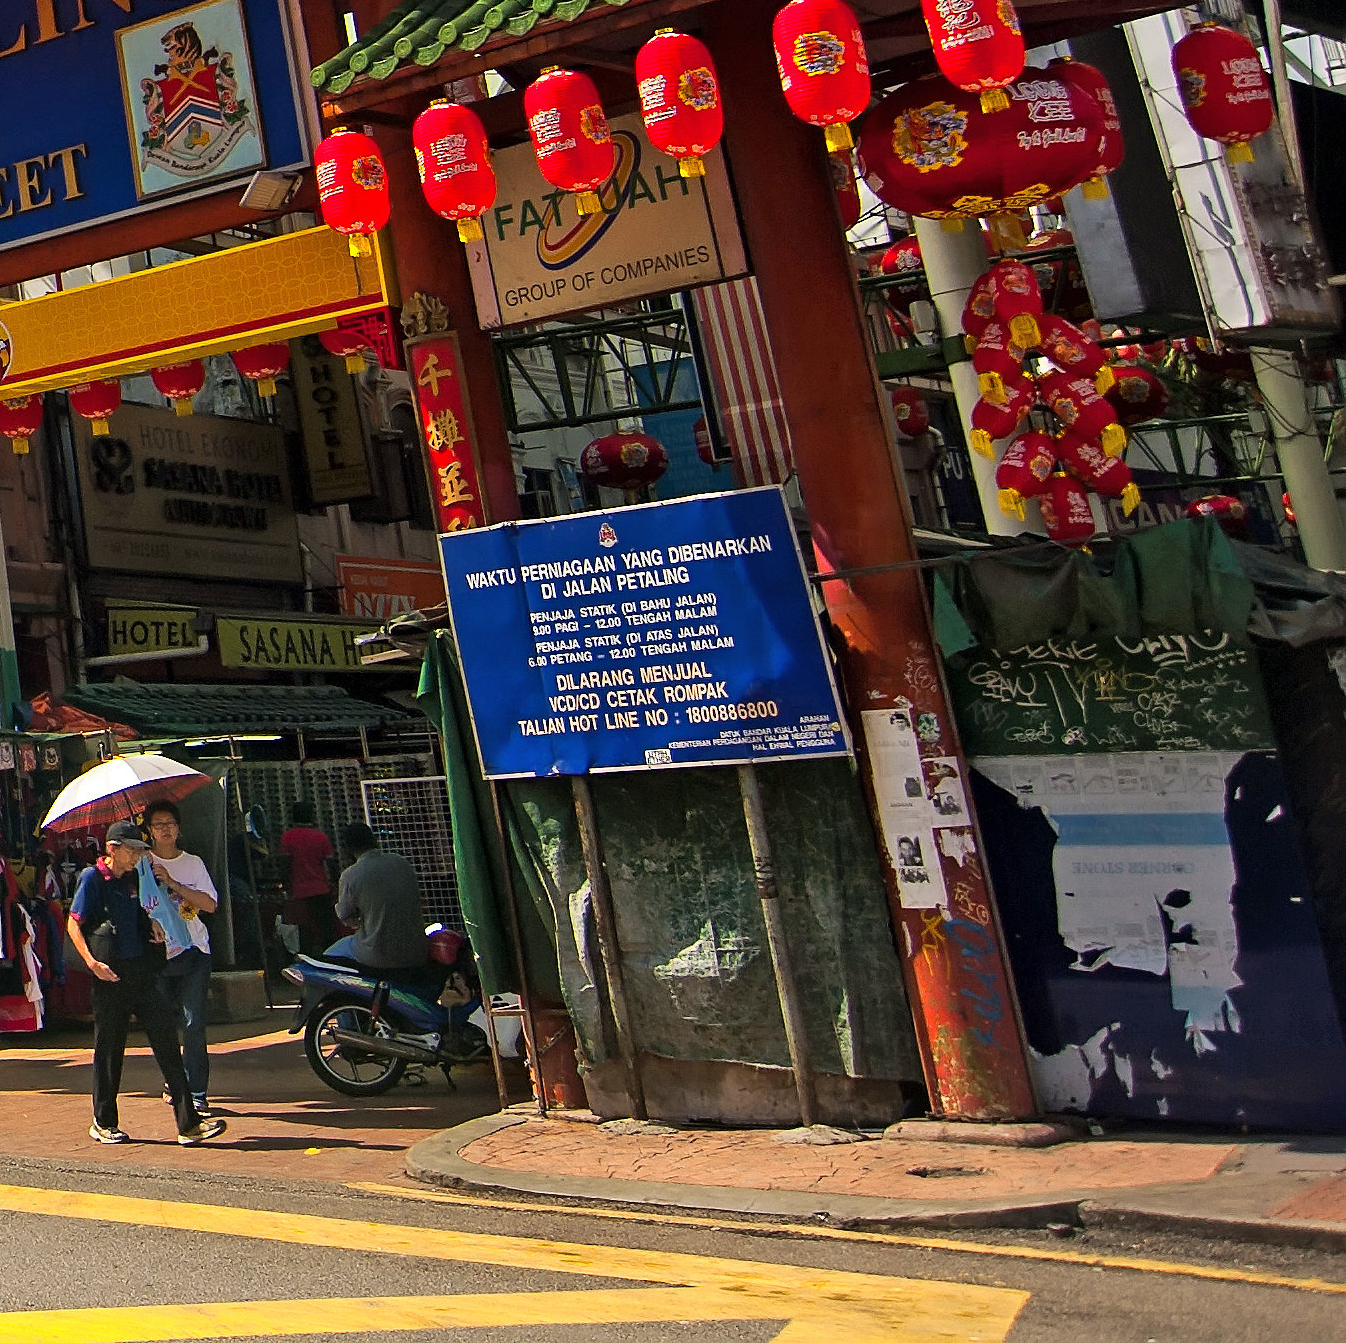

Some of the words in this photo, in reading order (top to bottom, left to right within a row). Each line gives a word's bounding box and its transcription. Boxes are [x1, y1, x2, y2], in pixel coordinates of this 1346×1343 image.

[1006, 80, 1068, 101] LOONG
[1028, 100, 1075, 123] KEE
[494, 165, 690, 241] FATUAH
[505, 278, 567, 307] GROUP
[571, 271, 596, 291] OF
[600, 245, 710, 285] COMPANIES
[466, 569, 517, 590] WAKTU
[521, 556, 616, 584] PERNIAGAAN
[621, 549, 664, 570] YANG
[667, 535, 772, 565] DIBENARKAN
[541, 583, 558, 600] DI
[562, 576, 612, 598] JALAN
[617, 567, 690, 591] PETALING
[530, 609, 576, 624] PENJAJA
[579, 604, 617, 619] STATIK
[621, 601, 637, 615] (DI
[640, 597, 671, 612] BAHU
[675, 592, 717, 608] JALAN)
[532, 622, 552, 636] 9.00
[555, 619, 579, 633] PAGI
[595, 616, 623, 630] 12.00
[627, 611, 672, 626] TENGAH
[675, 606, 718, 621] MALAM
[112, 620, 195, 647] HOTEL
[238, 624, 336, 665] SASANA
[528, 654, 548, 668] 6.00
[549, 649, 593, 666] PETANG
[608, 646, 636, 660] 12.00
[640, 641, 687, 657] TENGAH
[691, 636, 734, 652] MALAM
[535, 639, 580, 653] PENJAJA
[583, 634, 622, 649] STATIK
[625, 631, 641, 646] (DI
[645, 628, 674, 643] ATAS
[678, 623, 719, 639] JALAN)
[556, 669, 635, 692] DILARANG
[640, 661, 712, 682] MENJUAL
[549, 693, 600, 713] VCD/CD
[607, 687, 657, 708] CETAK
[663, 681, 729, 704] ROMPAK
[518, 716, 566, 737] TALIAN
[569, 713, 599, 733] HOT
[606, 710, 641, 730] LINE
[646, 708, 669, 727] NO
[686, 700, 779, 724] 1800886800
[1072, 861, 1127, 875] STONE
